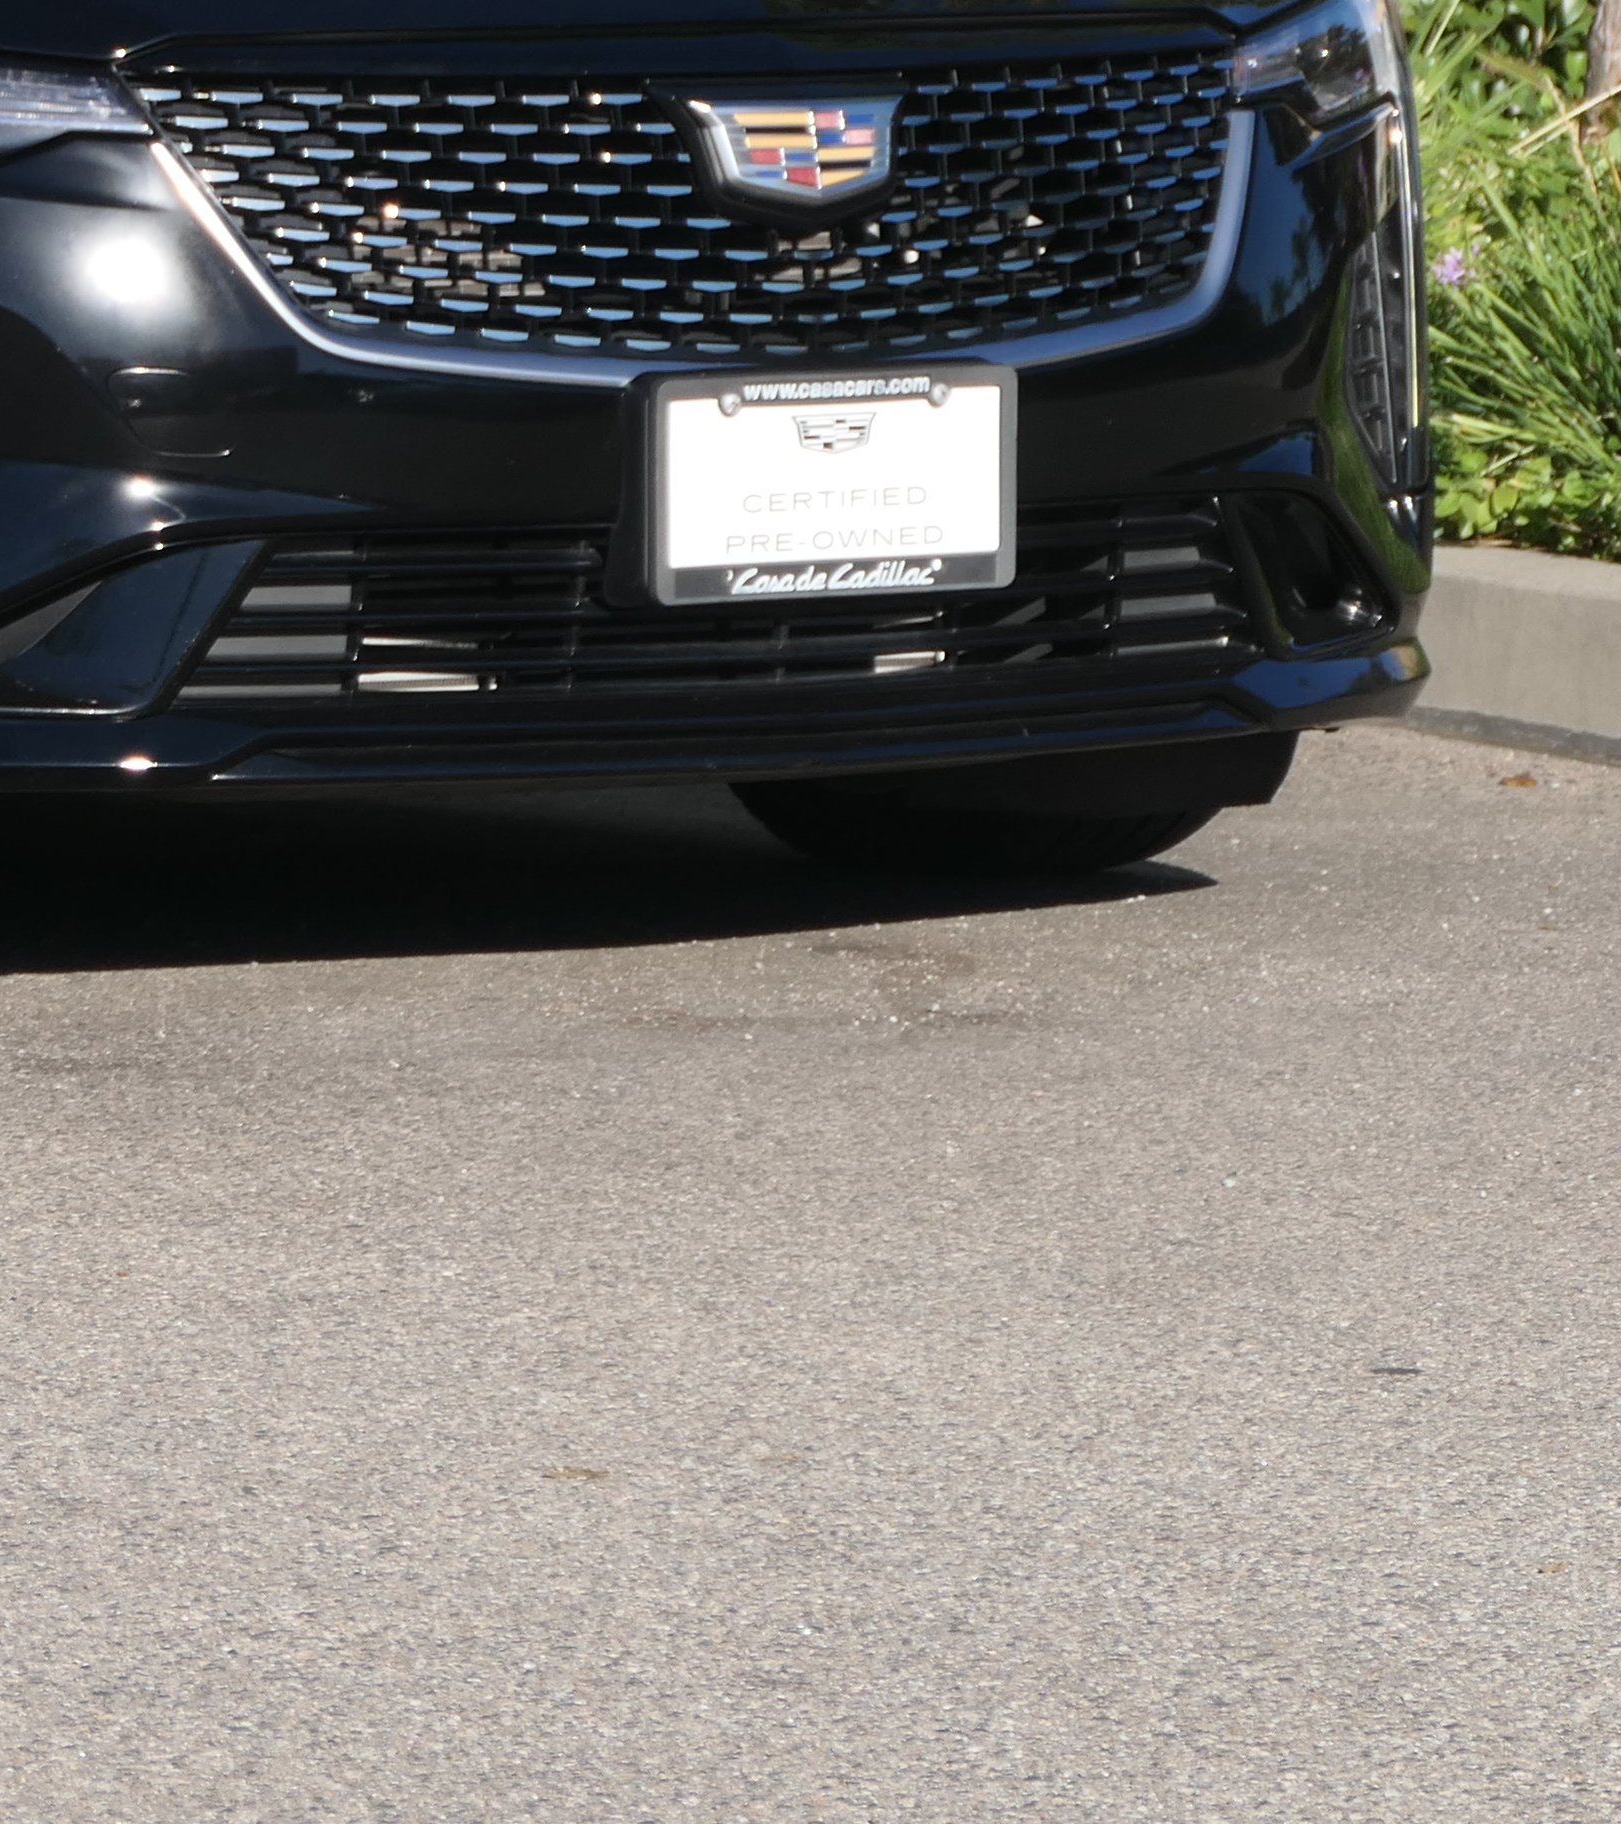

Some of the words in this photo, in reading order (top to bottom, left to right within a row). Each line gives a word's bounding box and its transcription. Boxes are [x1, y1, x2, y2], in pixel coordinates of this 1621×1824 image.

[743, 376, 931, 401] www.casacars.com
[742, 486, 927, 513] CERTIFIED
[725, 525, 944, 554] PRE-OWNED
[731, 567, 795, 594] Casa
[795, 565, 827, 591] de
[827, 560, 935, 589] Cadillac
